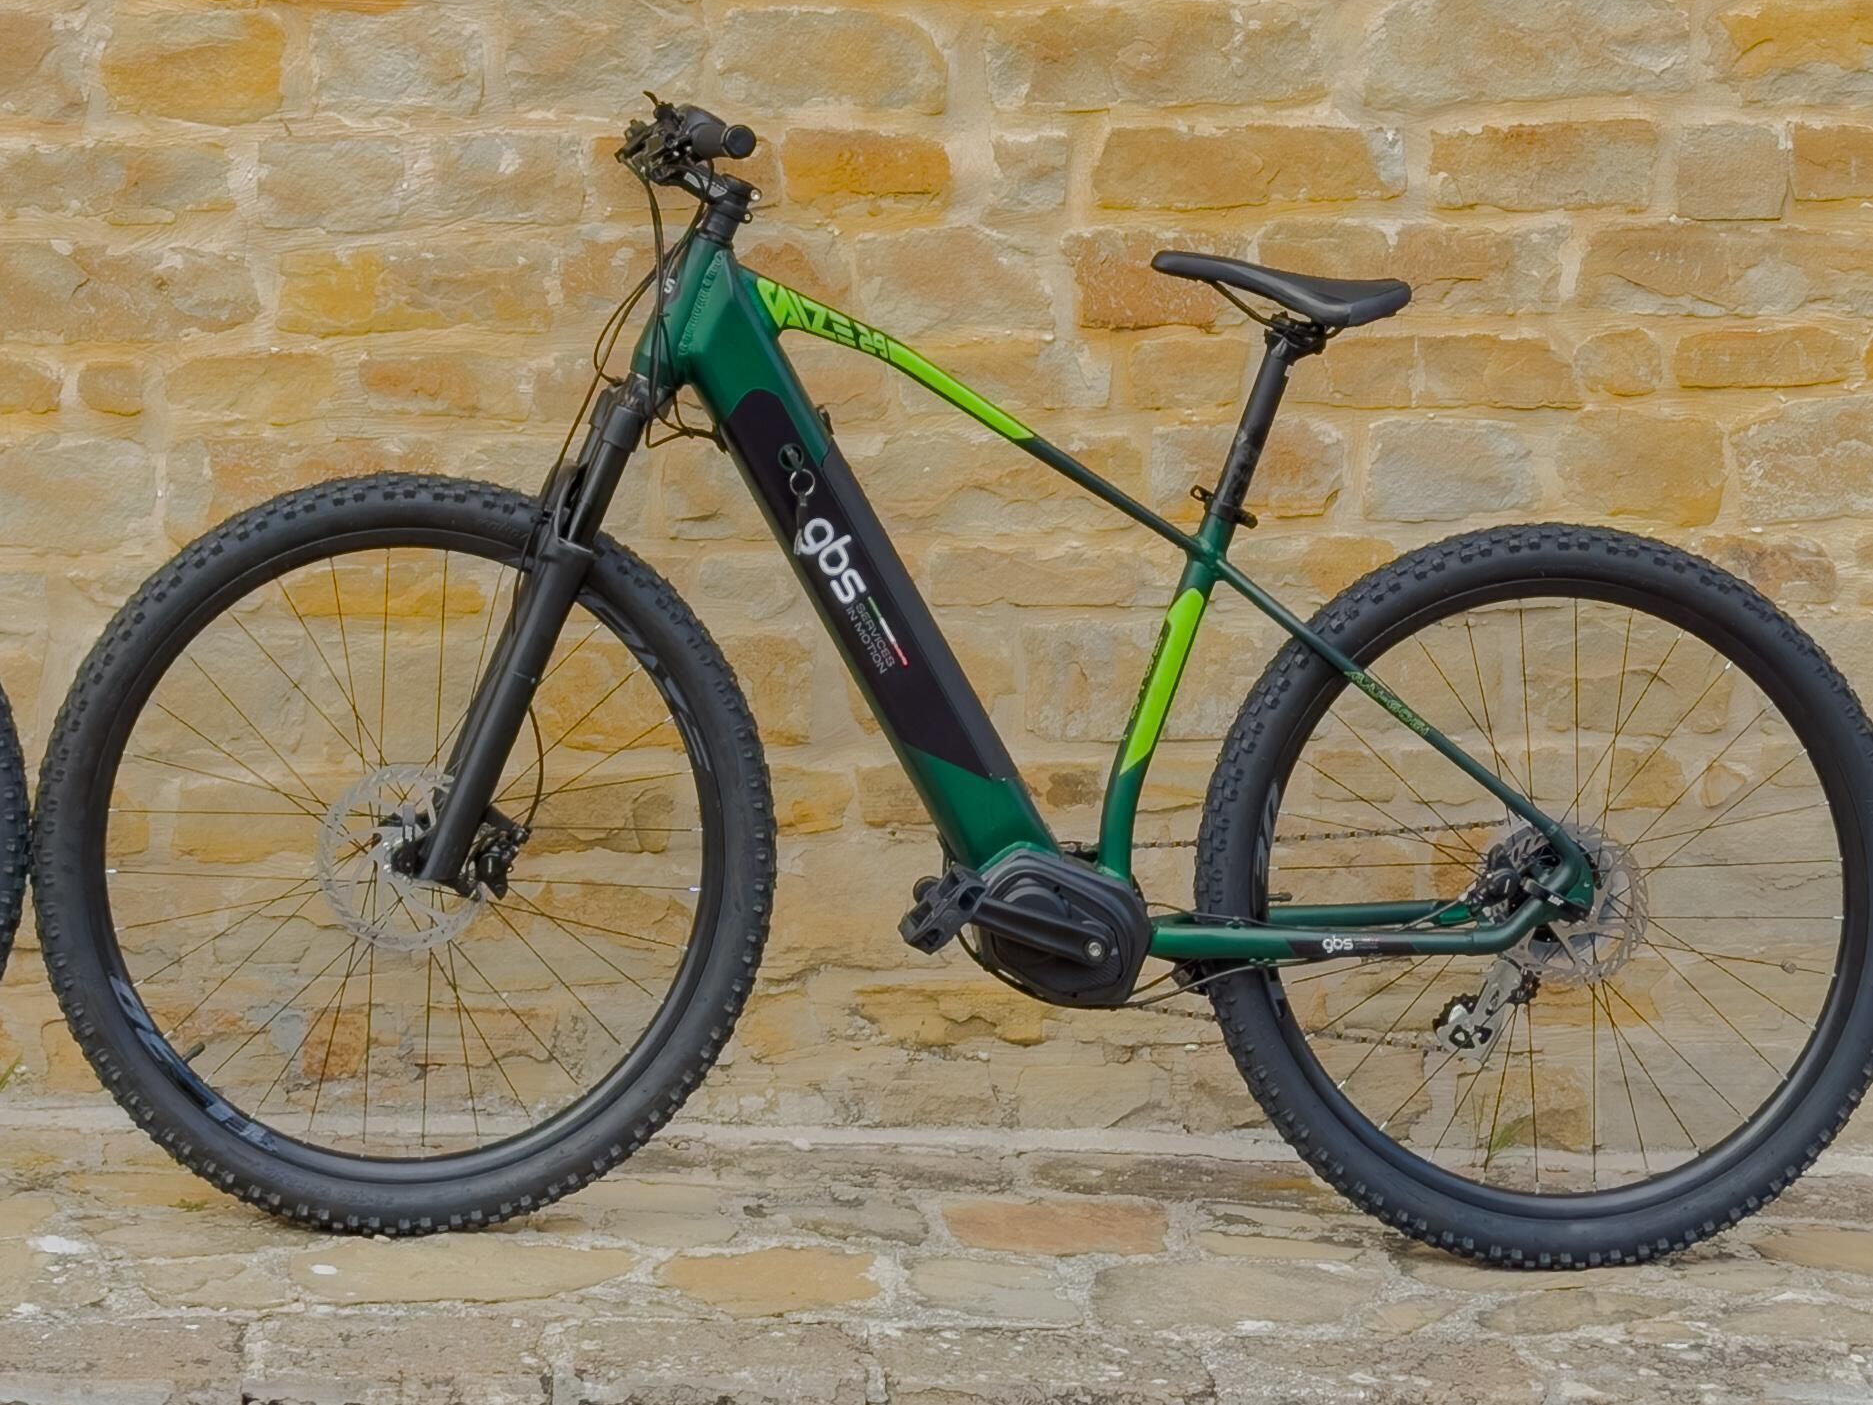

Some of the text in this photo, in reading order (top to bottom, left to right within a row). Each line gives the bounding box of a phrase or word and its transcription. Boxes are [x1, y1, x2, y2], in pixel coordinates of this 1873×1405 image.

[797, 517, 867, 604] gbs
[846, 606, 887, 674] IN MOTION
[855, 602, 895, 668] SERVICES
[1322, 934, 1354, 954] gbs
